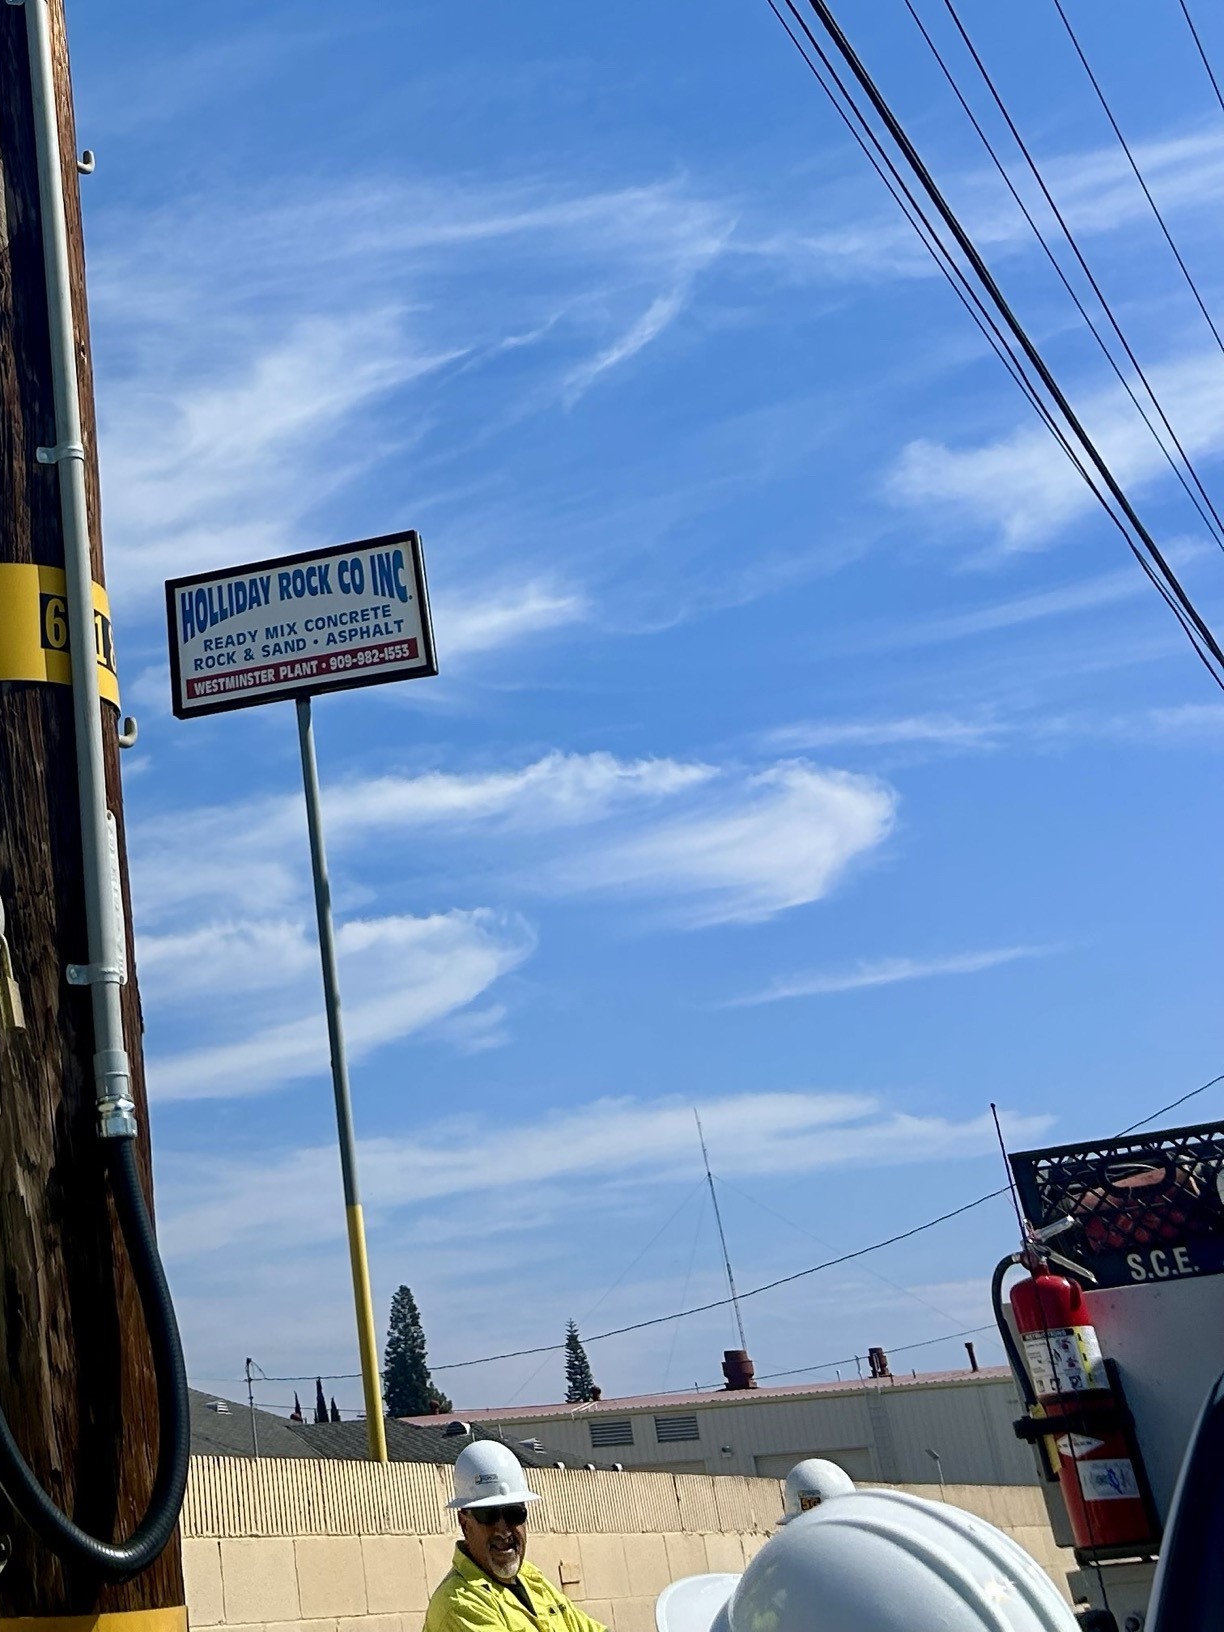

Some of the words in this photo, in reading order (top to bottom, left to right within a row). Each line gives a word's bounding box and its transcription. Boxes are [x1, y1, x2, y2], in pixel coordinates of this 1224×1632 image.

[181, 575, 271, 644] HOLLIDAY
[278, 563, 333, 601] ROCK
[338, 557, 365, 595] CO
[370, 549, 412, 603] INC.
[193, 651, 236, 671] ROCK
[243, 648, 255, 661] &
[261, 638, 306, 657] SAND
[326, 619, 404, 645] ASPHALT
[203, 629, 258, 652] READY
[265, 622, 297, 640] MIX
[304, 604, 392, 632] CONCRETE
[194, 668, 275, 695] WESTMINSTER
[279, 660, 318, 680] PLANT
[329, 643, 410, 670] 909-982-1553
[1126, 1246, 1200, 1280] S.C.E.
